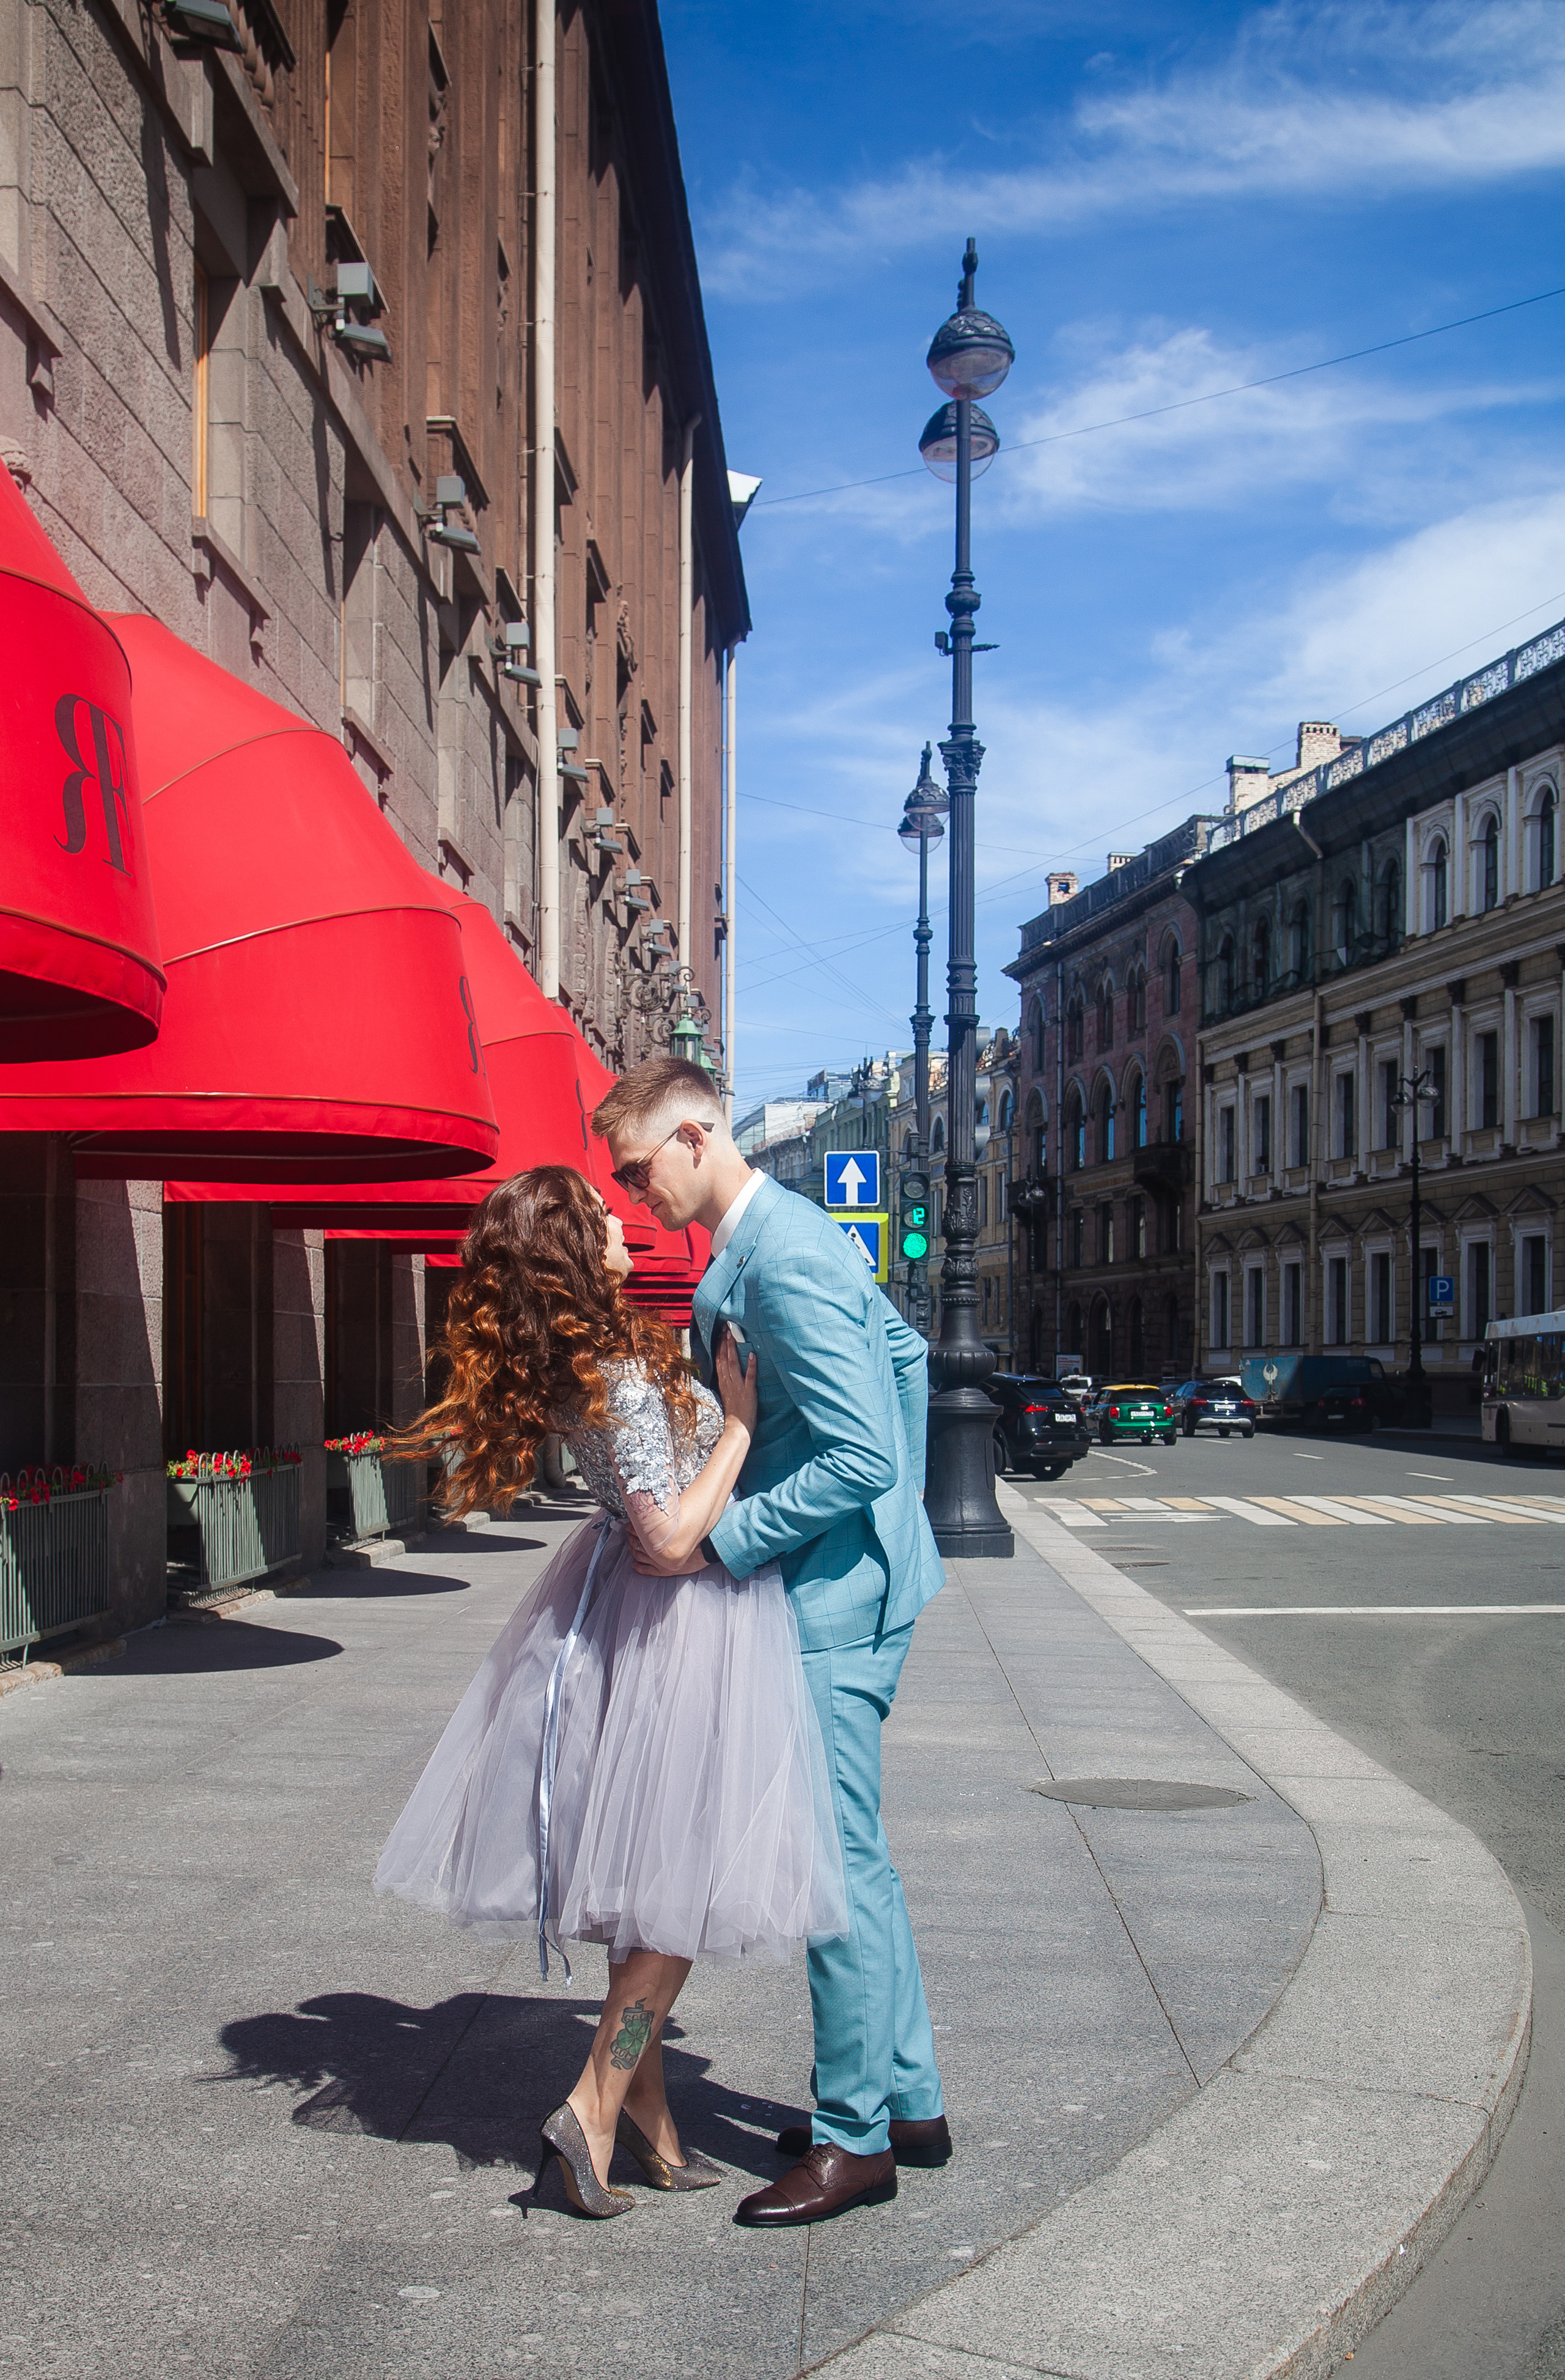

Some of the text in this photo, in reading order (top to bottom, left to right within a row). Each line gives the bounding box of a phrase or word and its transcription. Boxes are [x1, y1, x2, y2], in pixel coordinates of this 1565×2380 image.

[913, 1207, 925, 1225] 12
[1437, 1280, 1449, 1299] P
[614, 2046, 635, 2061] LUCK
